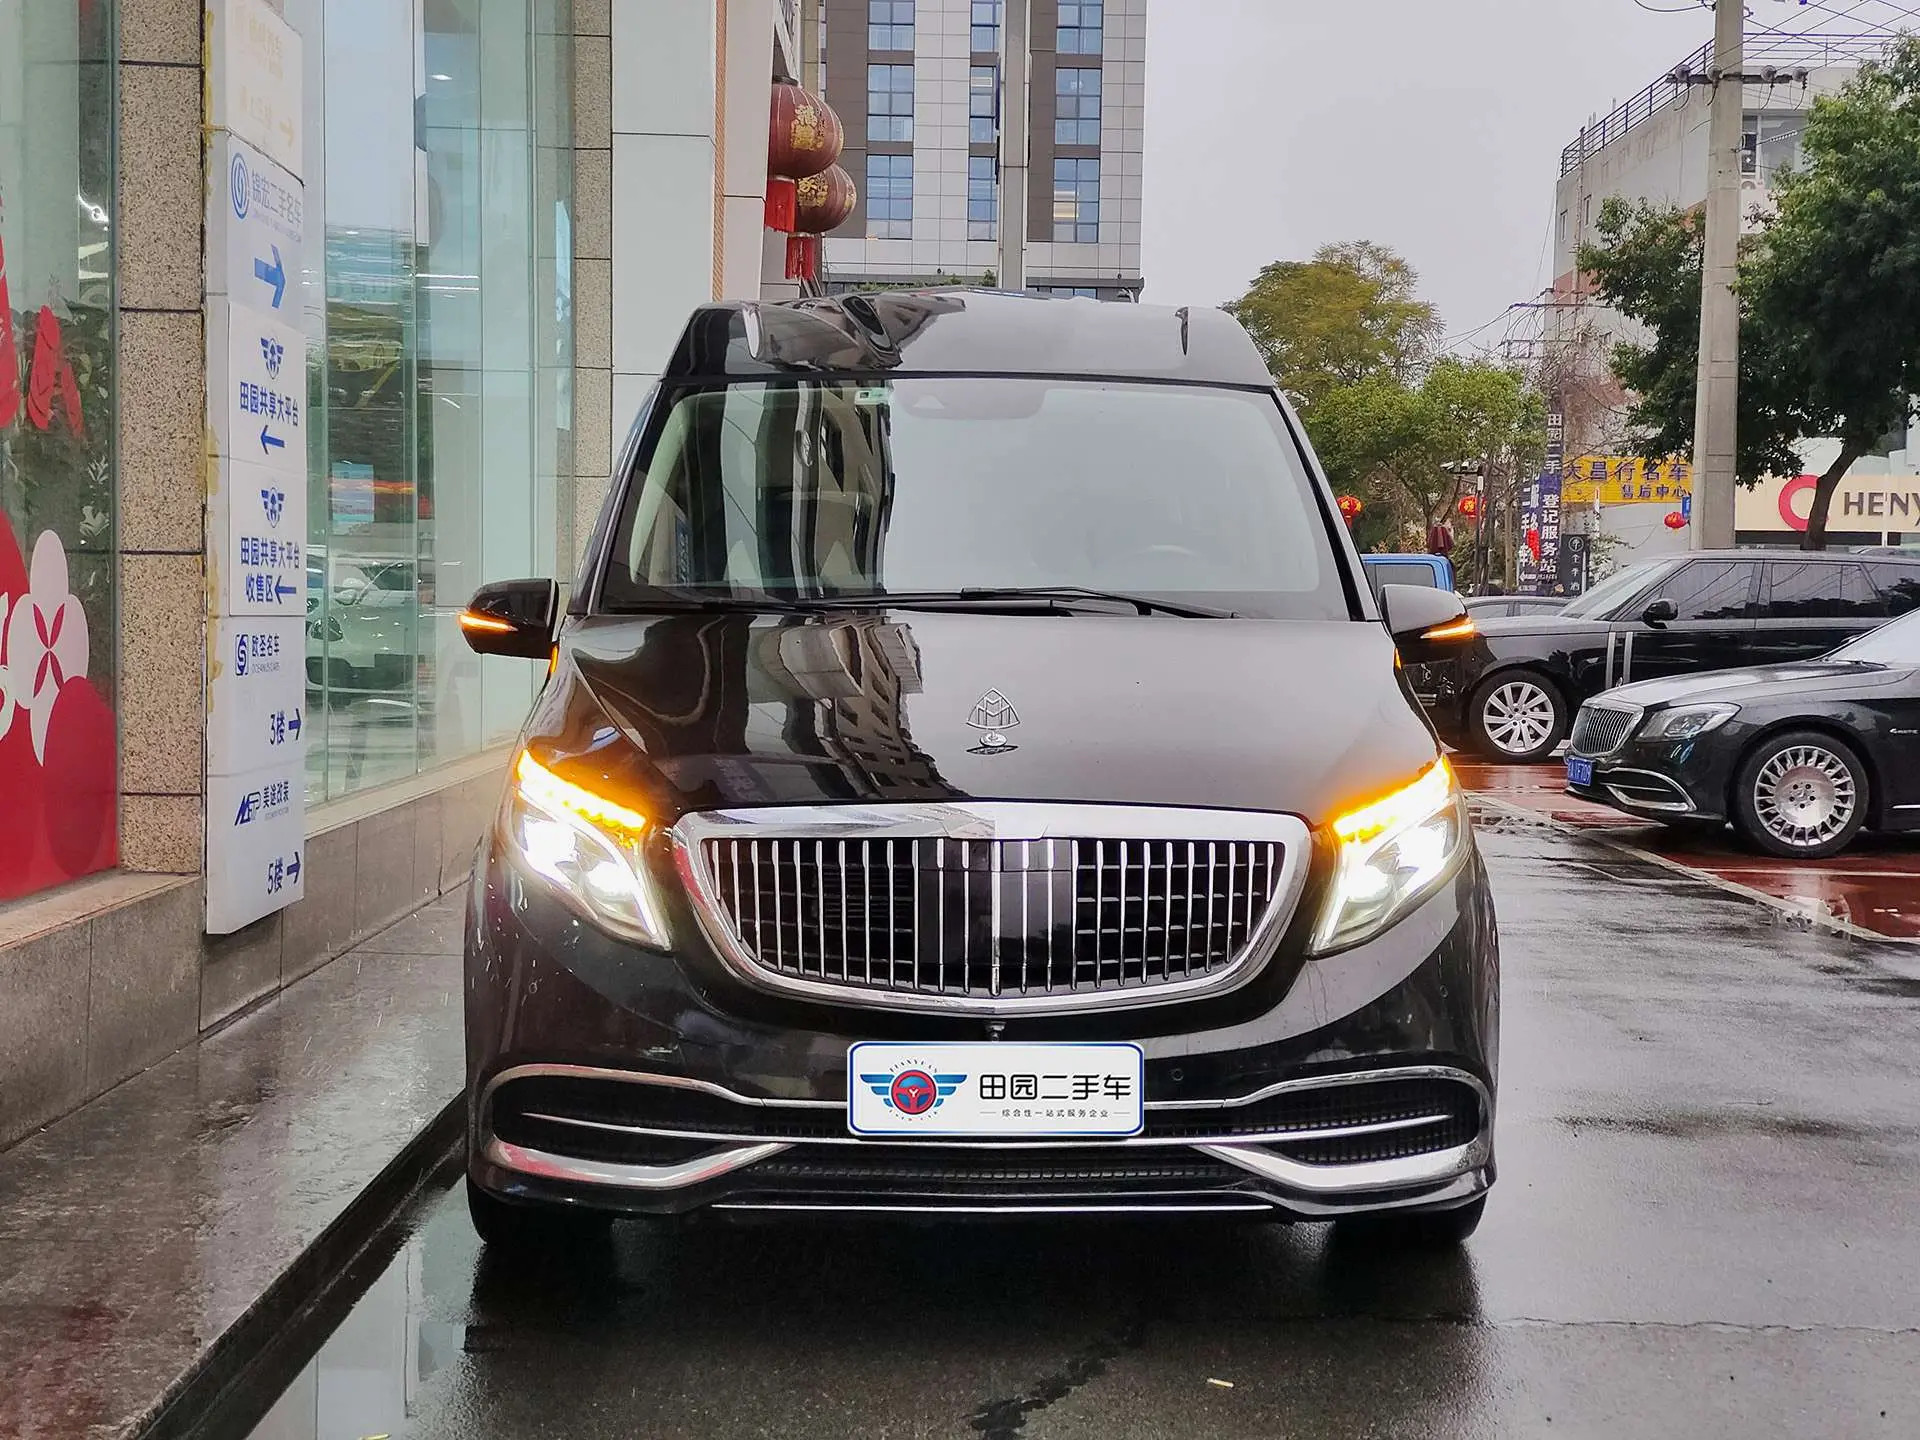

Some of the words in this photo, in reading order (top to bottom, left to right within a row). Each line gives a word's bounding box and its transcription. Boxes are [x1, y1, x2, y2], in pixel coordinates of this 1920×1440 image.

[239, 381, 300, 428] 田园共享大平台
[240, 535, 300, 570] 田园共享大平台
[245, 574, 274, 605] 收售区
[269, 710, 286, 746] 3楼
[267, 857, 284, 895] 5楼
[979, 1073, 1132, 1101] 田园二手车
[1001, 1108, 1109, 1118] 综合性一站式服务企业
